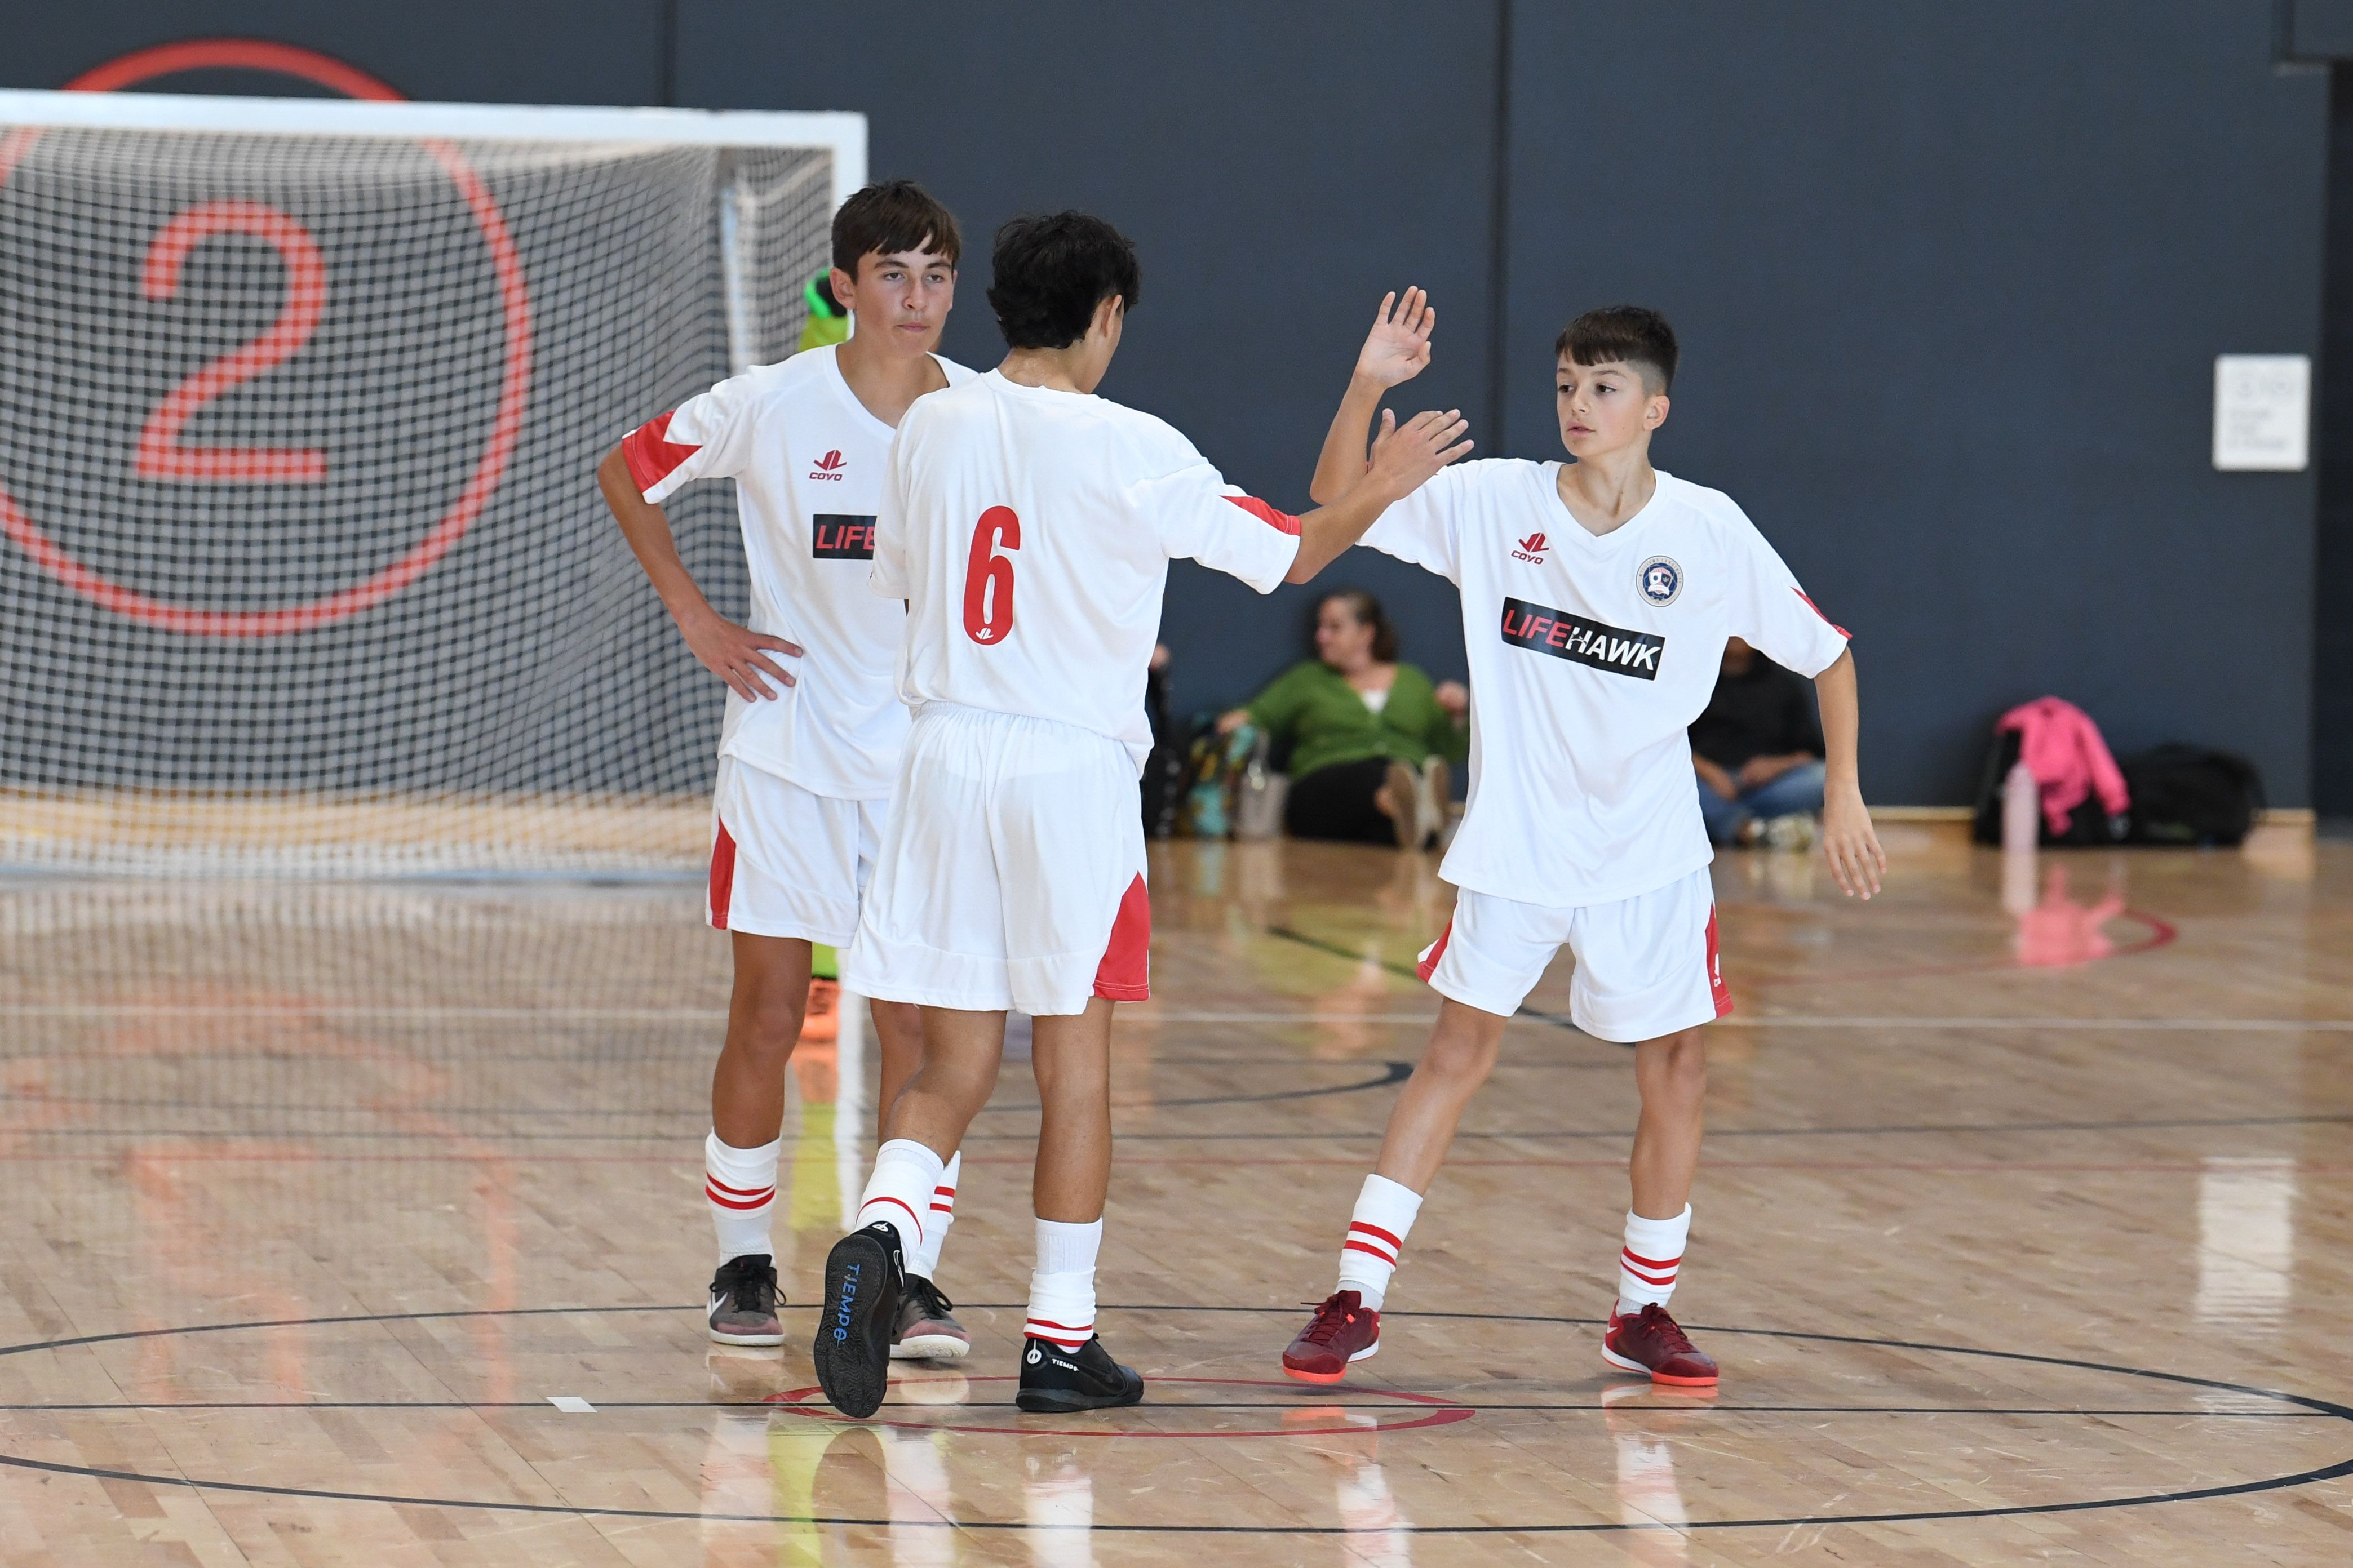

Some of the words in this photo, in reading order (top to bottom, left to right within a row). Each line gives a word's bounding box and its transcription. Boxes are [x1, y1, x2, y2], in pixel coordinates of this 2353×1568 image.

[137, 199, 327, 480] 2
[963, 505, 1021, 645] 6
[1503, 609, 1661, 670] LIFEHAWK
[833, 1264, 861, 1348] TIEMPO
[1052, 1358, 1080, 1371] TIEMPO
